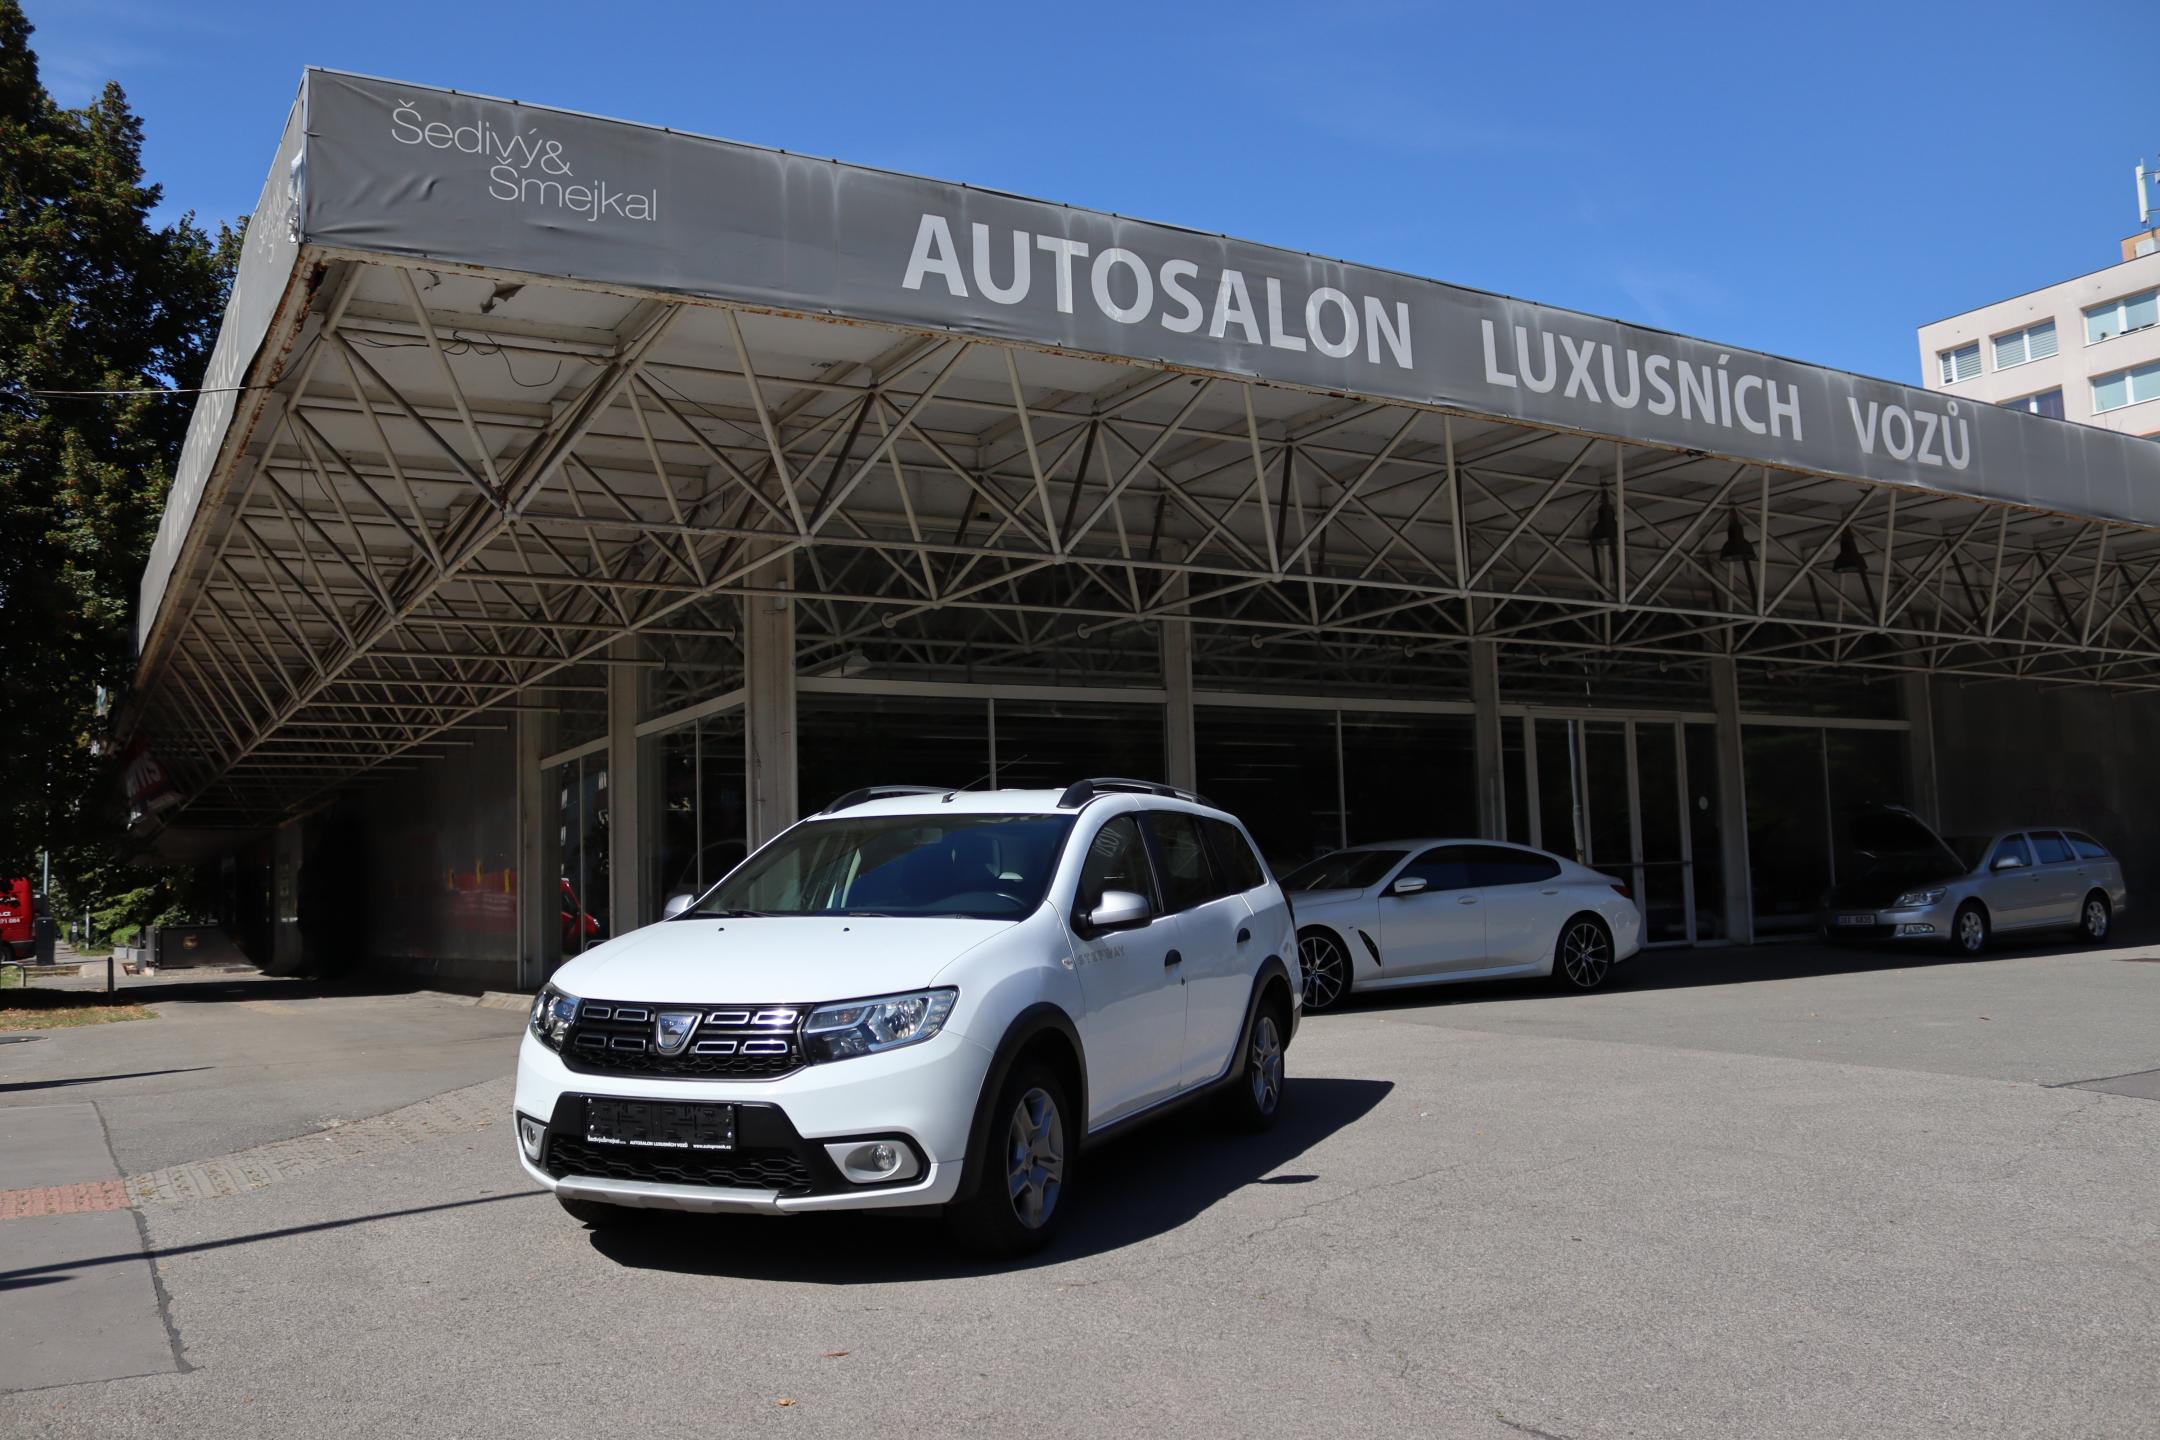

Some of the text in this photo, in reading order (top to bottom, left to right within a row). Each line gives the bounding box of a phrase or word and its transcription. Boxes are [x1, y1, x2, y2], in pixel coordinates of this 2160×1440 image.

[391, 99, 574, 176] Šedivý&
[489, 156, 657, 222] Šmejkal
[901, 213, 1971, 470] AUTOSALON LUXUSNÍCH VOZŮ
[1077, 944, 1125, 967] STEPWAY
